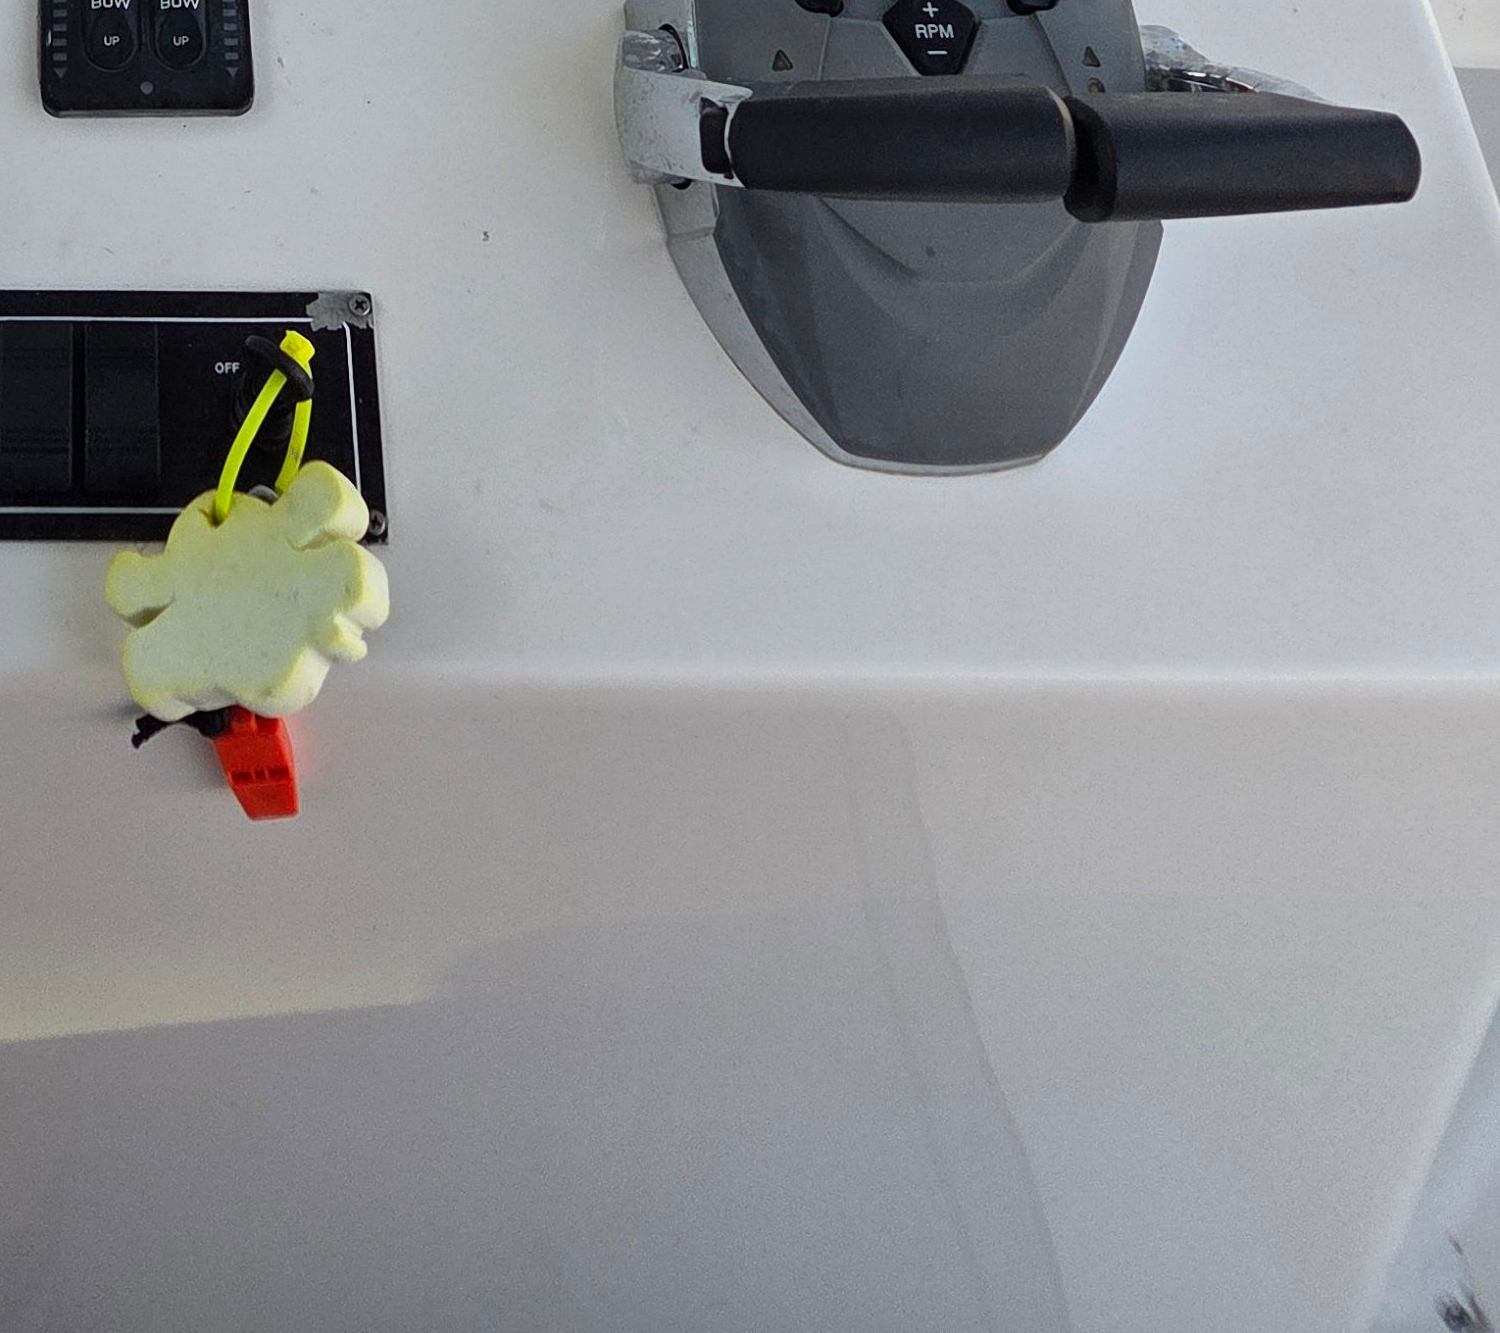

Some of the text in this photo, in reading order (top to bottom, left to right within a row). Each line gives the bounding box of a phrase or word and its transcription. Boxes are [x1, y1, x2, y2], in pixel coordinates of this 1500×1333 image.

[914, 23, 955, 39] RPM
[103, 35, 120, 47] UP
[172, 35, 190, 47] UP
[214, 361, 241, 375] OFF
